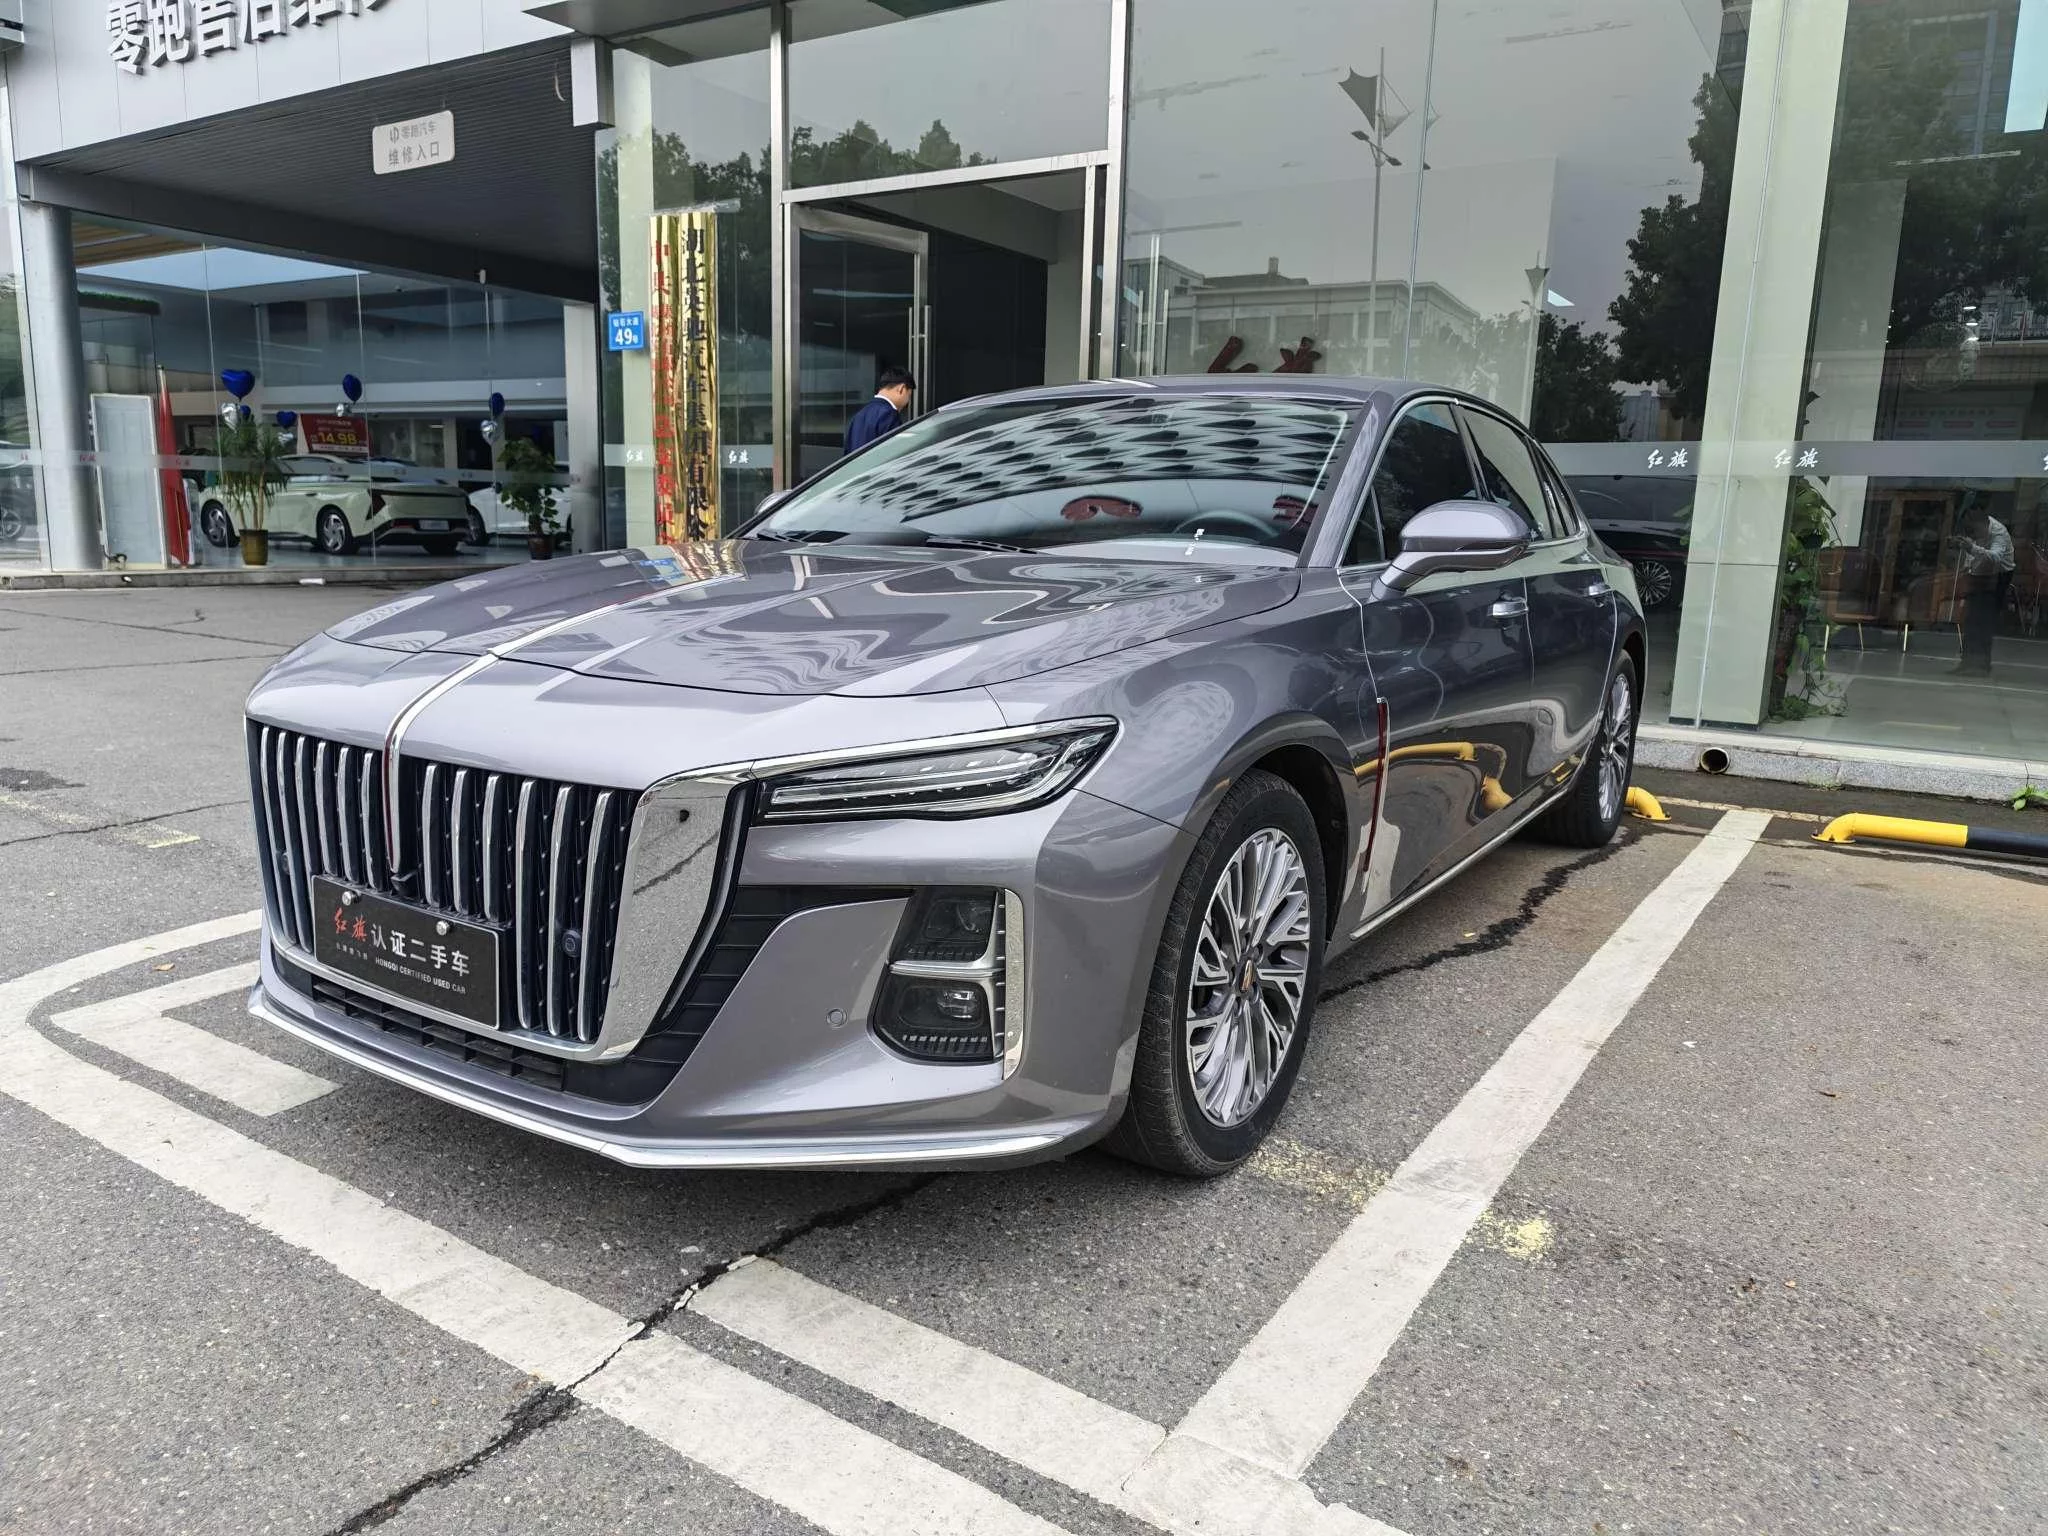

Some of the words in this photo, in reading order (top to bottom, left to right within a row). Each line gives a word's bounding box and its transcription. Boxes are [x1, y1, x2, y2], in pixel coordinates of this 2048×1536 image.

[388, 141, 440, 168] 维修入口
[1647, 448, 1688, 469] 红旗
[1774, 448, 1819, 469] 红旗
[376, 956, 398, 972] HONGQI
[400, 965, 431, 983] CERTIFIED
[433, 977, 450, 990] USED
[452, 983, 466, 994] CAR
